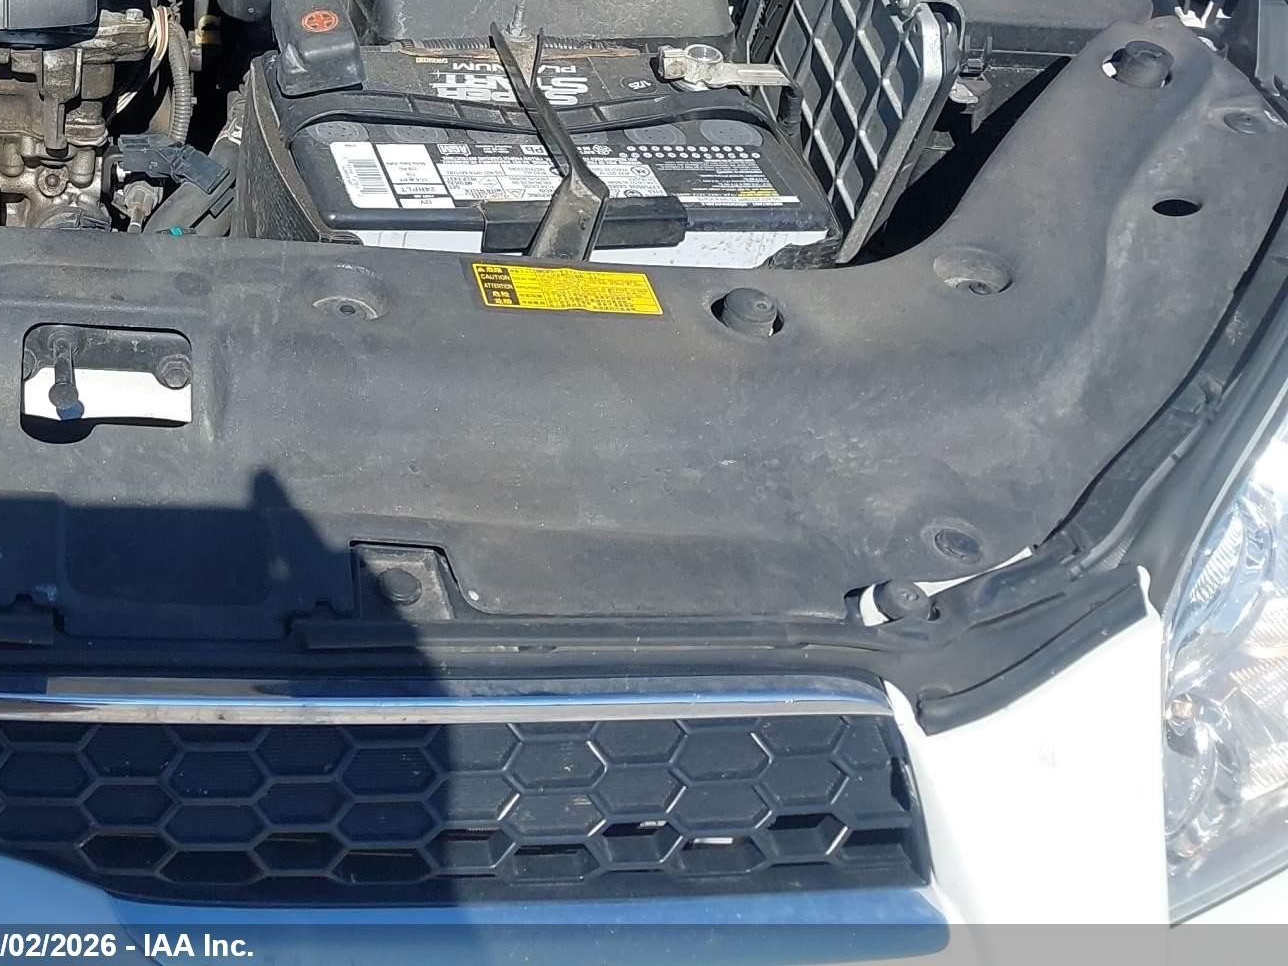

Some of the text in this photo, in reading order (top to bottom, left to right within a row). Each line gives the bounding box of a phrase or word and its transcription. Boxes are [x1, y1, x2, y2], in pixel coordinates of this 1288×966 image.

[437, 87, 578, 106] SPER
[439, 145, 467, 154] AGM
[480, 273, 510, 281] CAUTION
